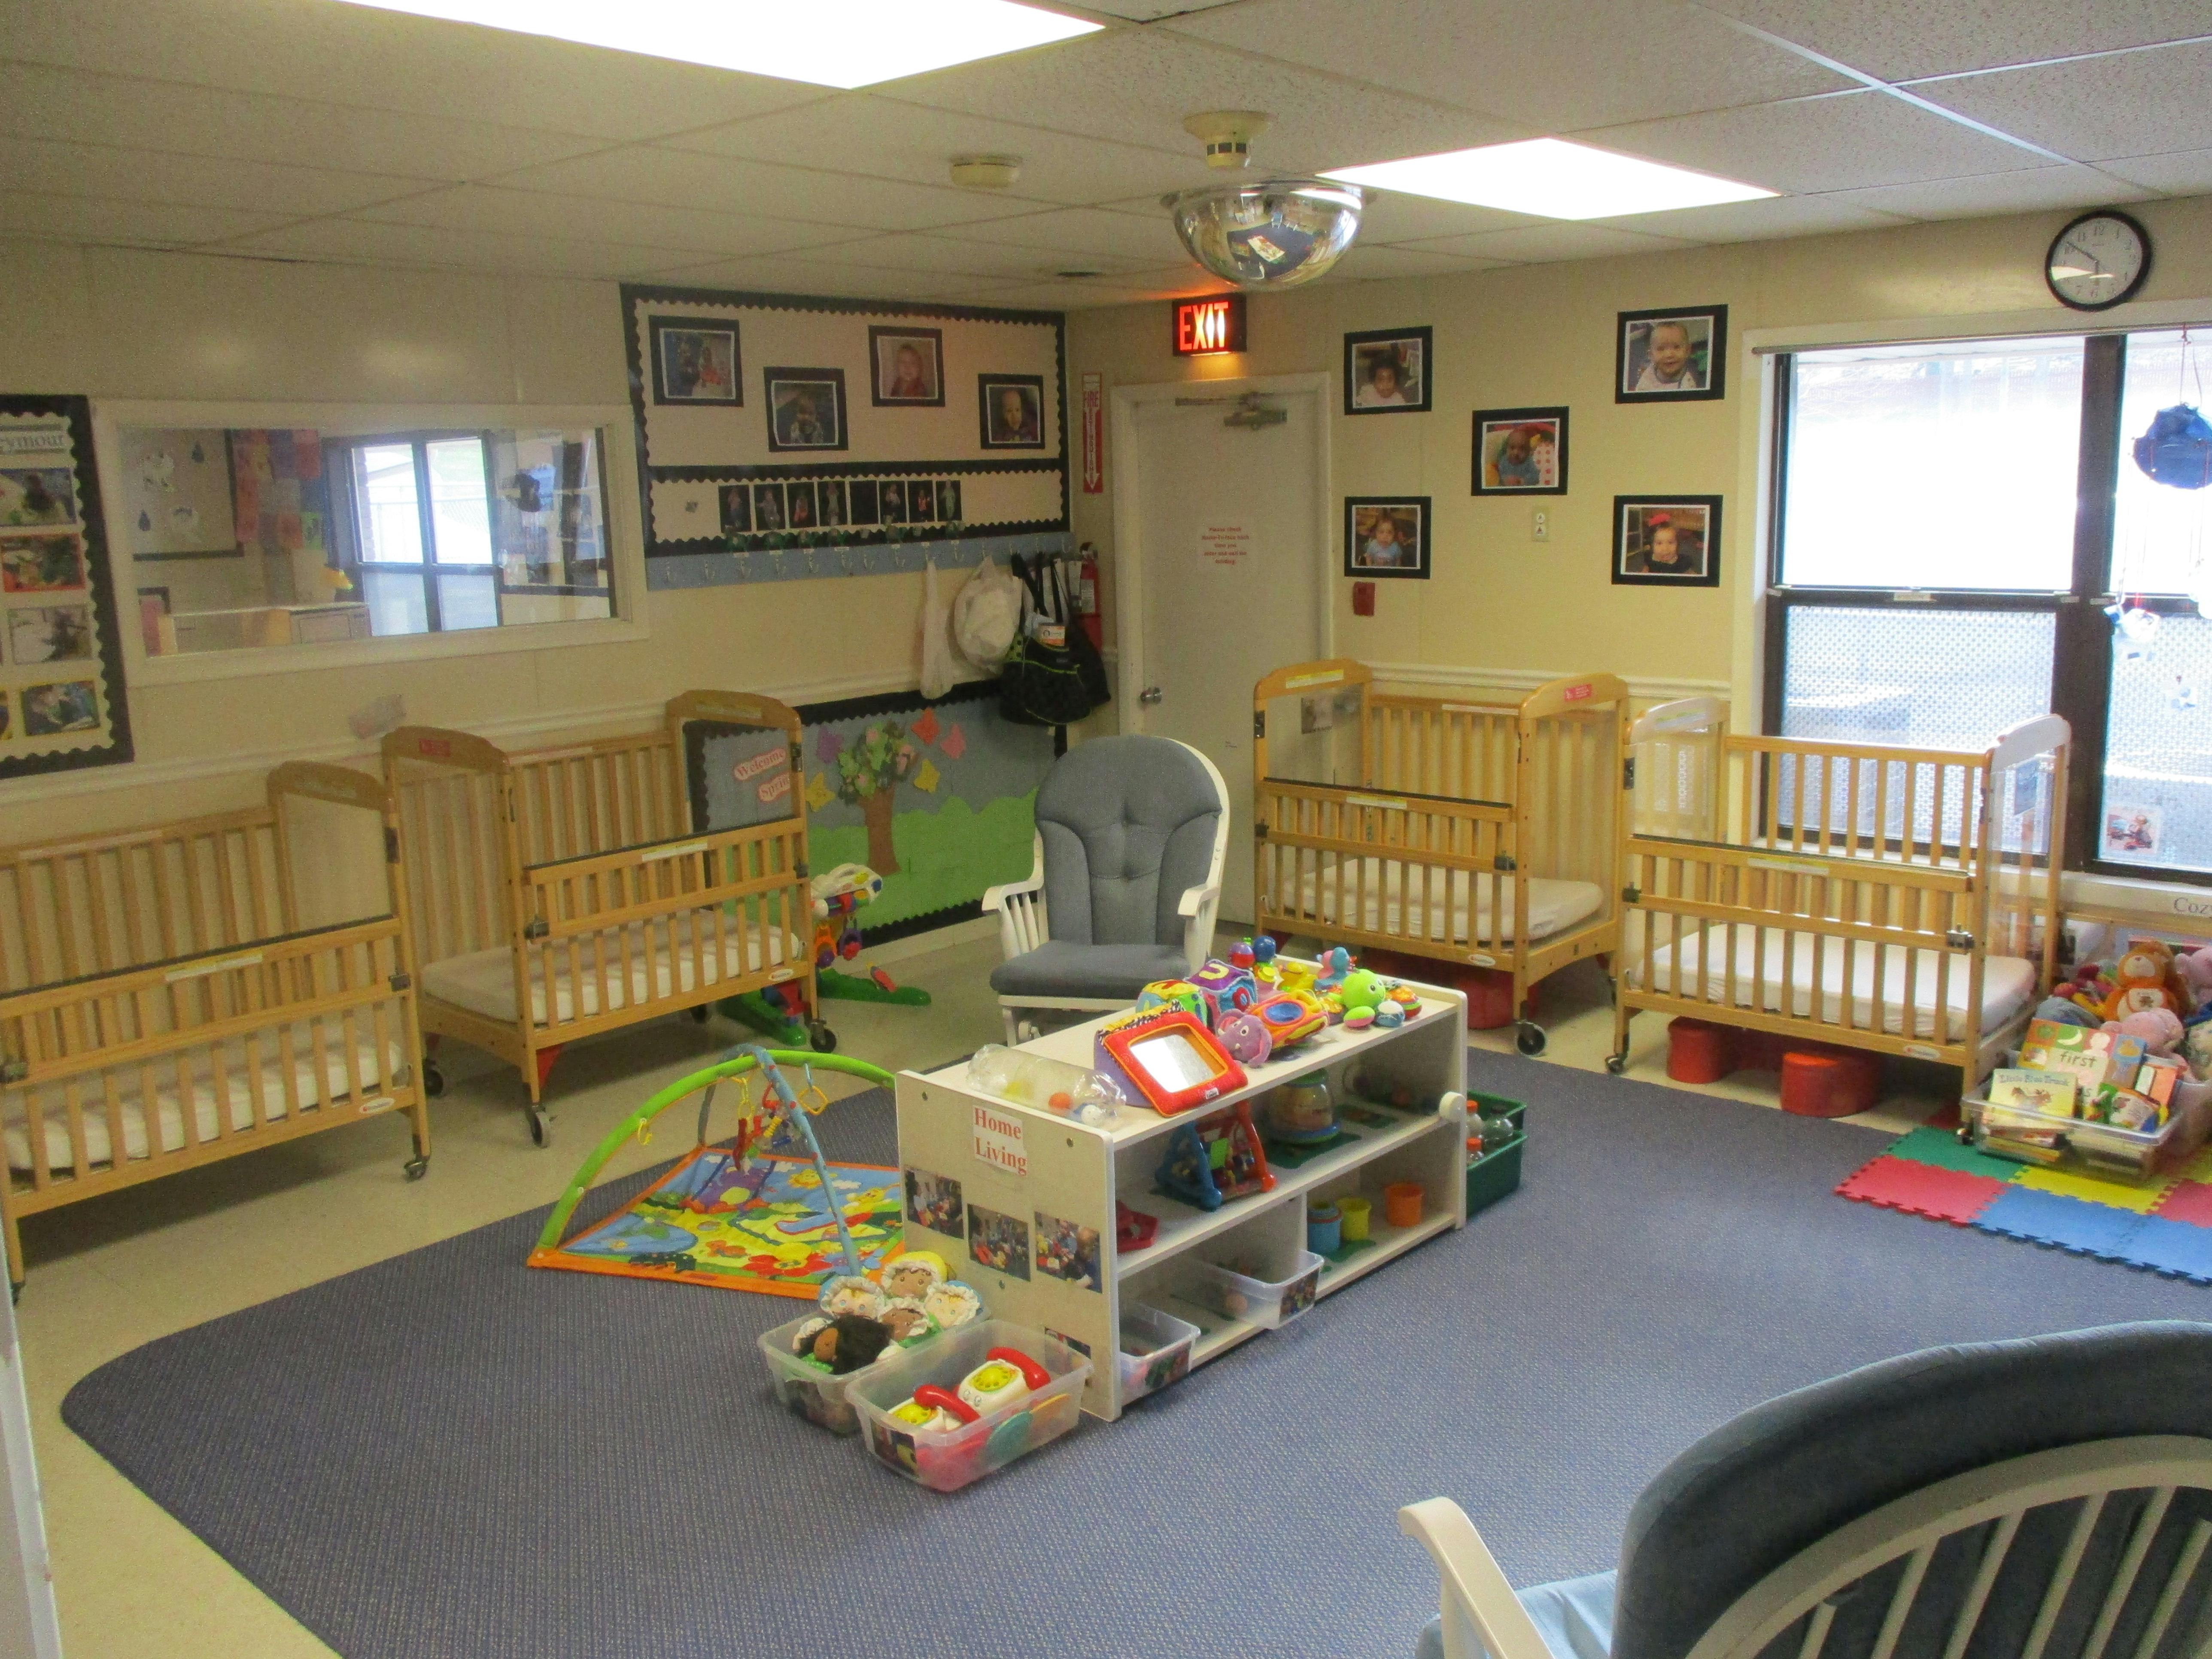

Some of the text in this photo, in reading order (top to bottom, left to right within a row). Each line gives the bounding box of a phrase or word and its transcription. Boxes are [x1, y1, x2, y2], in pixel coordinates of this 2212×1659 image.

[1179, 301, 1228, 350] EXIT
[761, 775, 790, 798] Sprin
[2173, 896, 2212, 915] Coz
[2060, 1051, 2097, 1068] first
[975, 1107, 1022, 1139] Home
[975, 1136, 1027, 1177] Living
